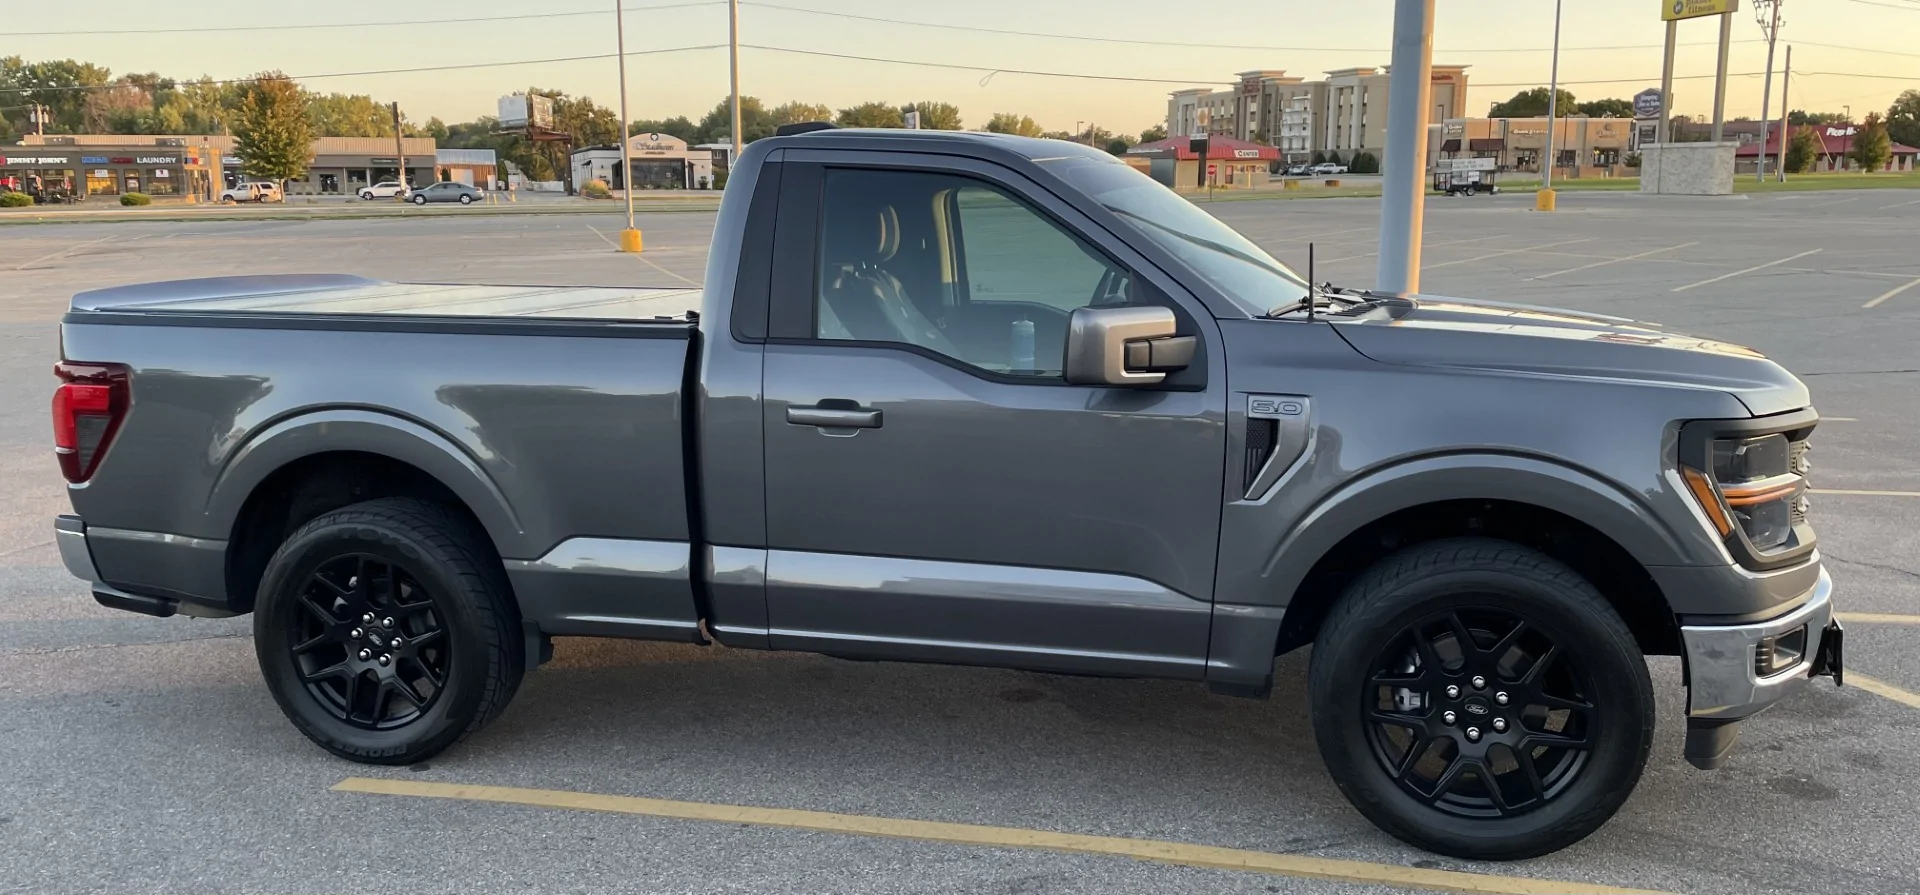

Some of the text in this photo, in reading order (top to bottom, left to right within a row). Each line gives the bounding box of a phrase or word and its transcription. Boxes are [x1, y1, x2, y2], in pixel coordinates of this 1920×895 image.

[6, 157, 68, 165] JIMMY JOHN'S
[1251, 400, 1303, 416] 5.0
[1467, 704, 1487, 714] Ford
